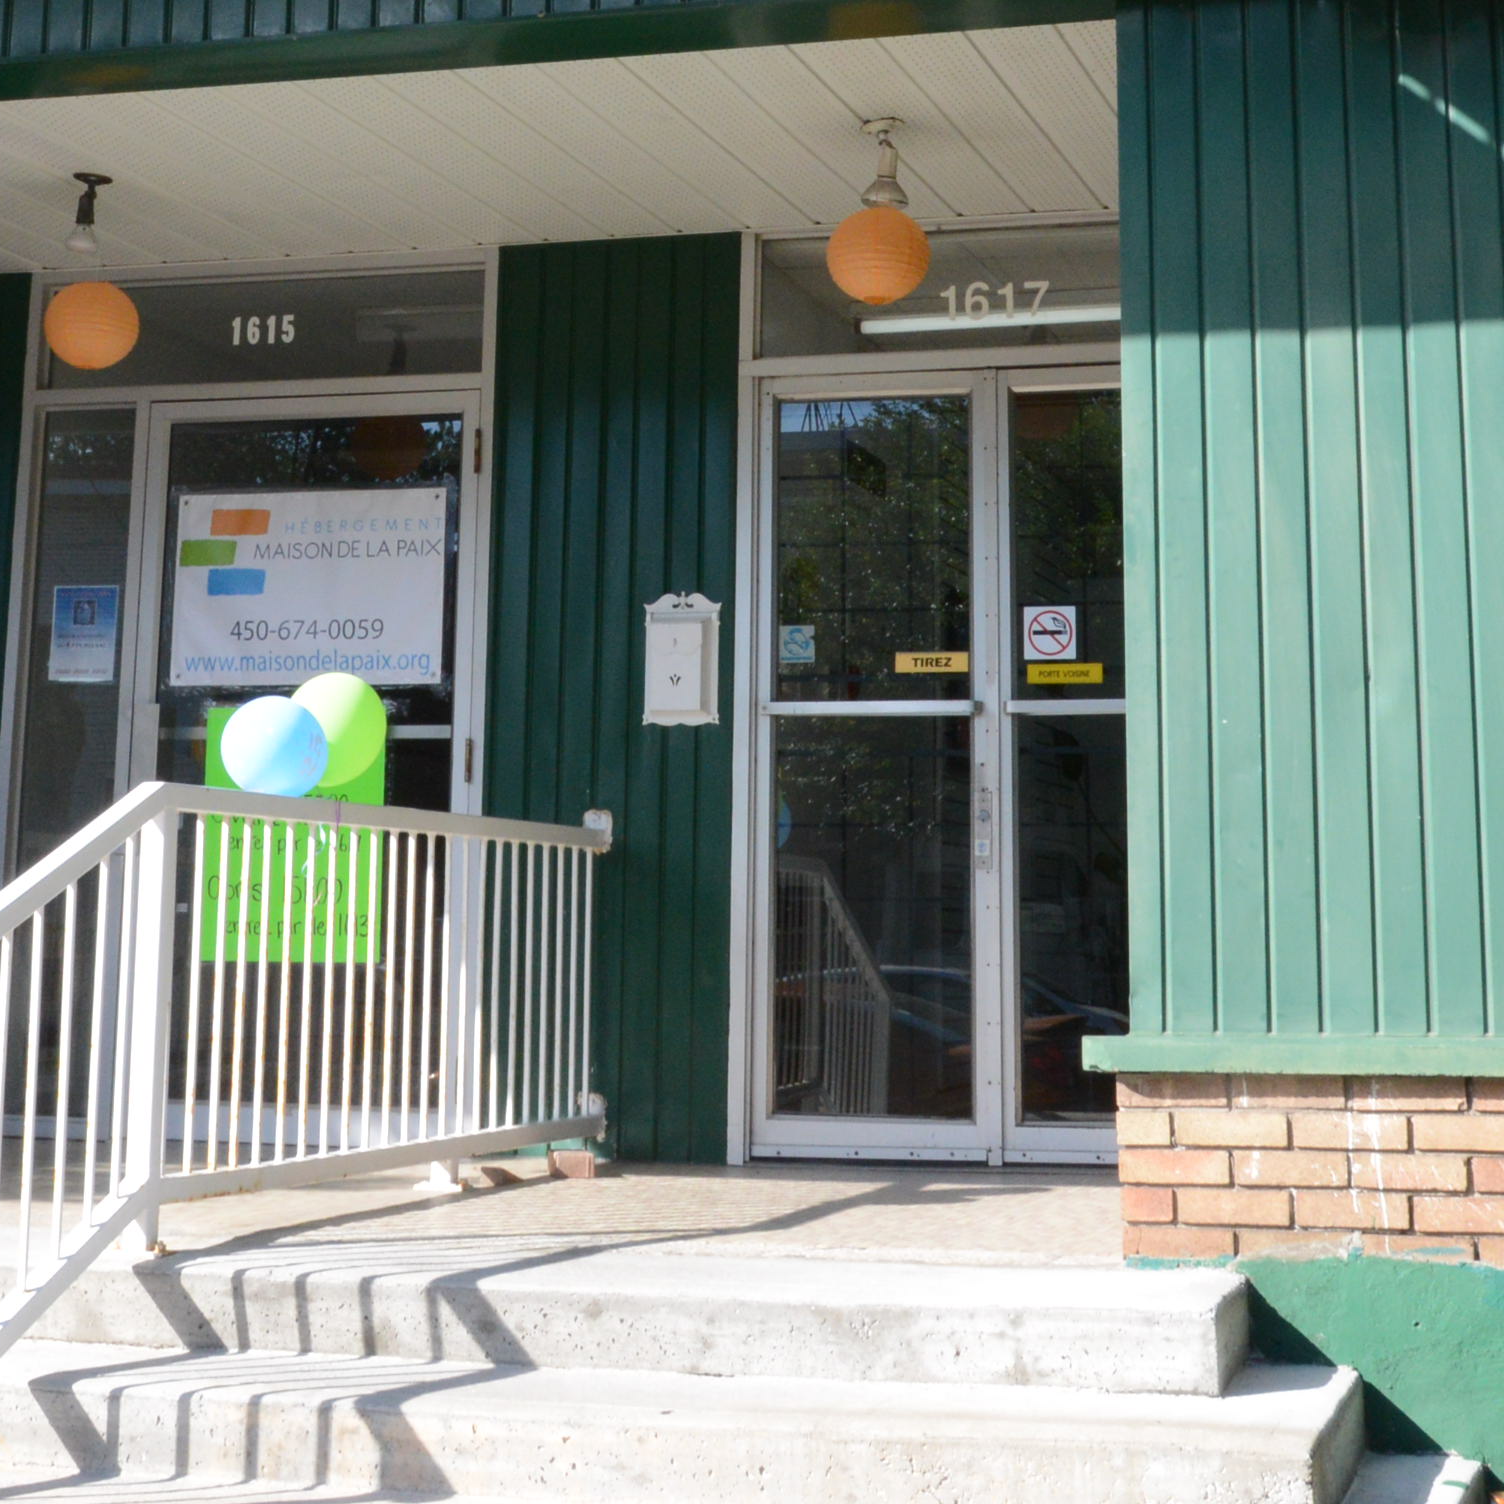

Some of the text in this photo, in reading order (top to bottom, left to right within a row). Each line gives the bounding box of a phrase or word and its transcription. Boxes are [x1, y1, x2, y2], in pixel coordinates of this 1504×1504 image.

[939, 280, 1050, 321] 1617
[231, 314, 295, 346] 1615
[284, 516, 444, 535] HÉBERGEMENT
[253, 538, 443, 560] MAISON DE LA PAIX
[230, 618, 385, 641] 450-674-0059
[184, 649, 432, 676] www.maisondelapaix.org
[911, 656, 953, 669] TIREZ
